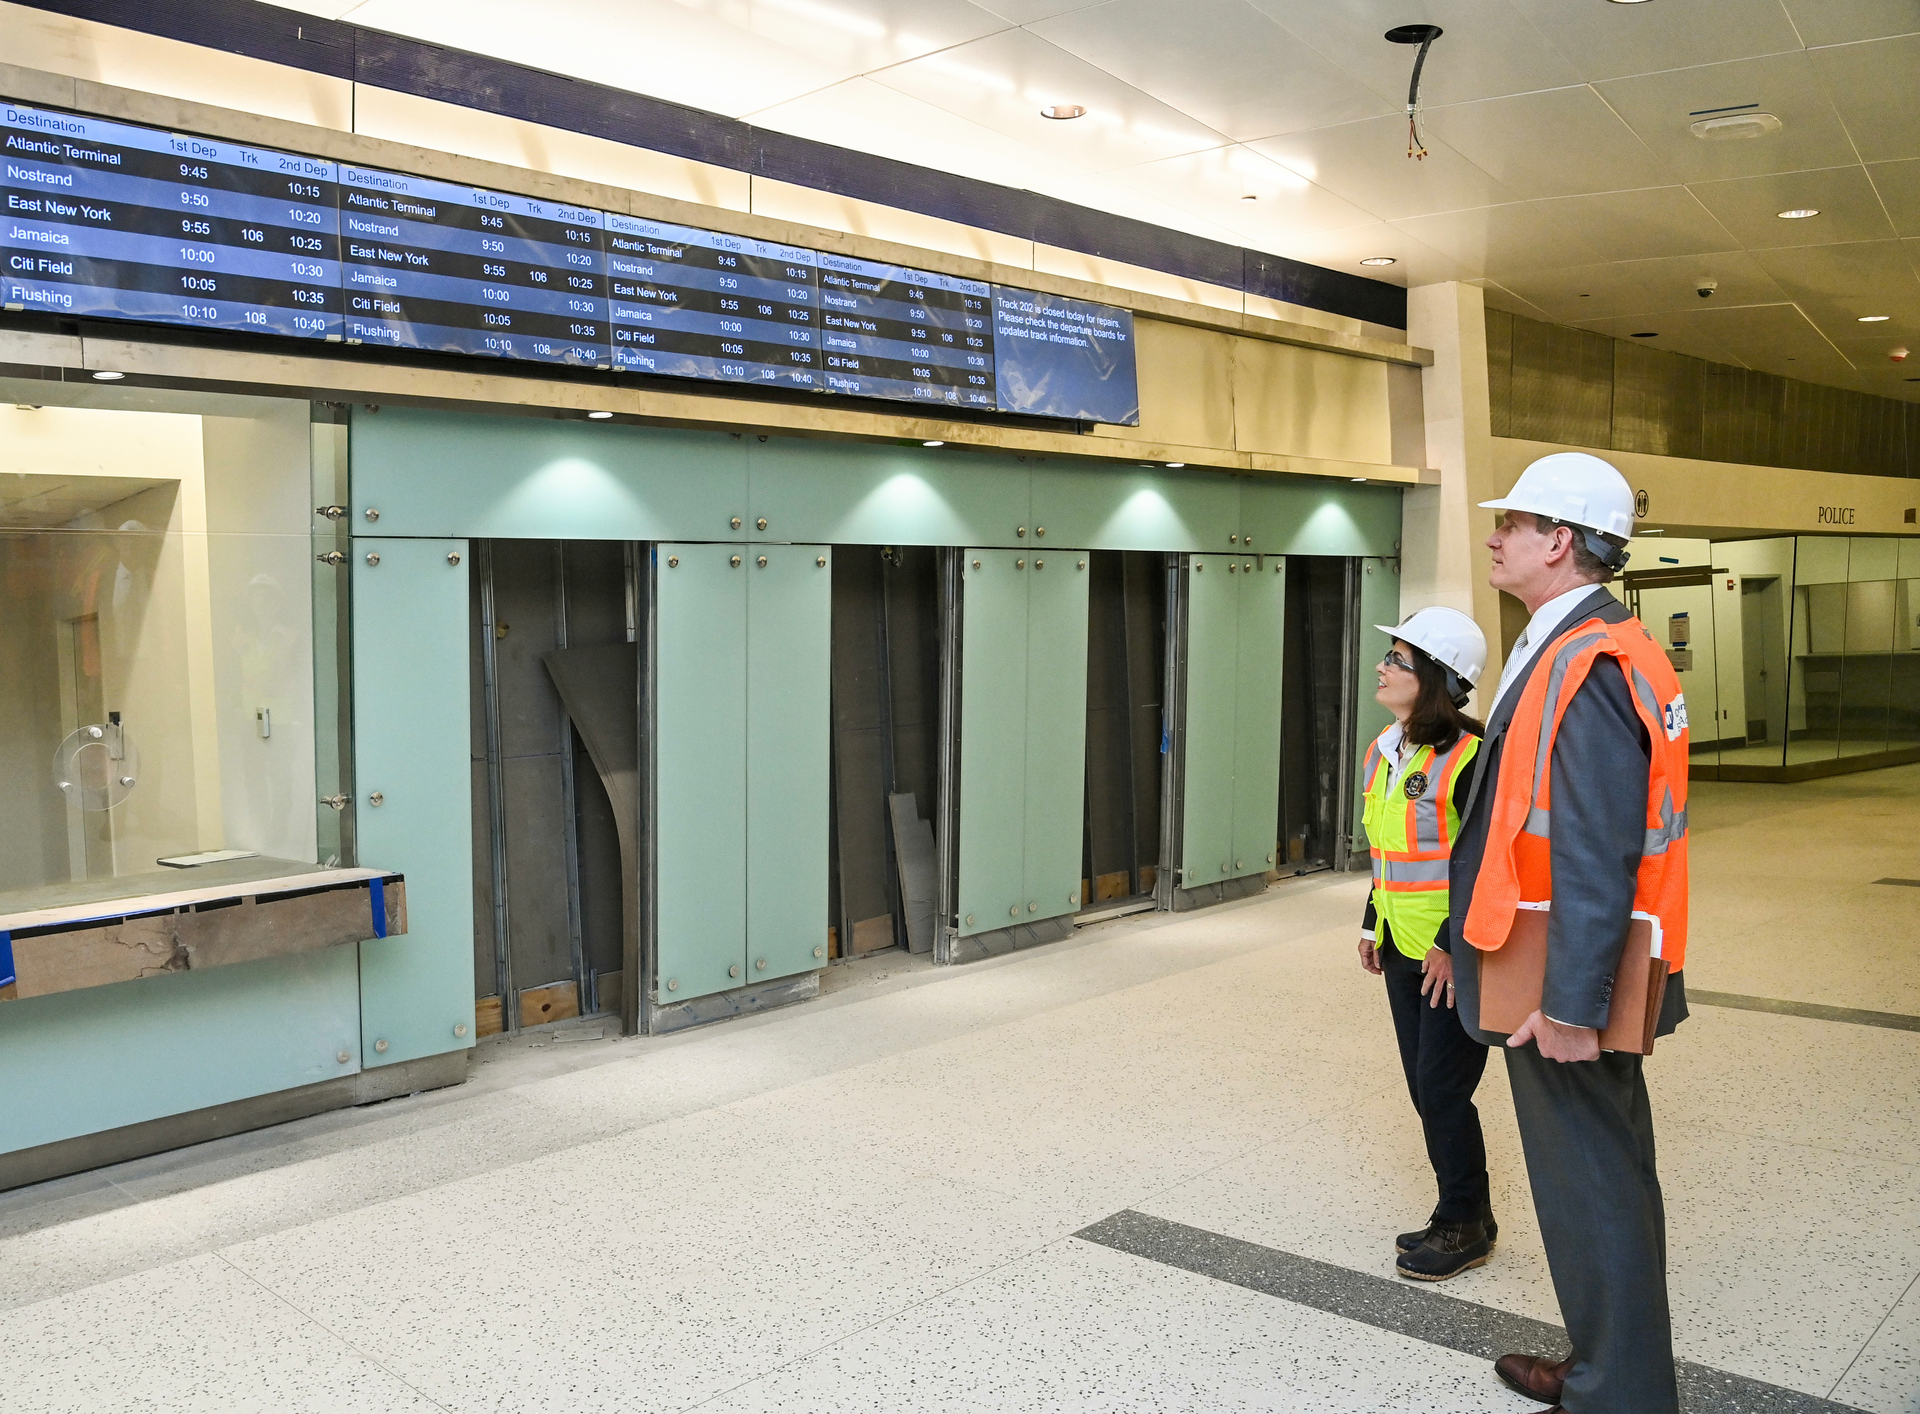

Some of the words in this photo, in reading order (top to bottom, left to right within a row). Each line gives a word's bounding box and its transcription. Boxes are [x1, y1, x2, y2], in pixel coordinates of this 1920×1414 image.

[7, 110, 85, 134] Destination
[170, 139, 188, 152] 1st
[192, 142, 217, 158] Dep
[240, 151, 258, 164] Trk
[279, 158, 300, 170] 2nd
[305, 162, 328, 178] Dep
[6, 136, 59, 155] Atlantic
[63, 145, 121, 165] Terminal
[180, 165, 208, 179] 9:45
[288, 183, 319, 197] 10:15
[7, 166, 72, 186] Nostrand
[181, 192, 209, 206] 9:50
[289, 210, 320, 224] 10:20
[348, 171, 408, 191] Destination
[473, 194, 487, 205] 1st
[490, 196, 510, 209] Dep
[527, 202, 542, 214] Trk
[558, 209, 575, 220] 2nd
[578, 211, 596, 225] Dep
[8, 196, 42, 211] East
[45, 201, 77, 216] New
[80, 206, 111, 221] York
[182, 220, 210, 235] 9:55
[241, 229, 263, 242] 106
[290, 236, 322, 250] 10:25
[348, 193, 388, 210] Atlantic
[391, 201, 435, 217] Terminal
[481, 216, 503, 228] 9:45
[565, 230, 590, 242] 10:15
[9, 226, 69, 244] Jamaica
[180, 248, 215, 263] 10:00
[291, 263, 323, 277] 10:30
[349, 219, 398, 236] Nostrand
[482, 240, 504, 252] 9:50
[566, 253, 591, 266] 10:20
[612, 219, 659, 235] Destination
[711, 236, 723, 246] 1st
[725, 238, 741, 250] Dep
[755, 244, 767, 254] Trk
[780, 249, 794, 258] 2nd
[796, 251, 810, 263] Dep
[612, 238, 644, 252] Atlantic
[646, 244, 682, 258] Terminal
[718, 256, 736, 267] 9:45
[786, 268, 806, 279] 10:15
[10, 256, 33, 270] Citi
[39, 260, 72, 275] Field
[181, 276, 216, 291] 10:05
[292, 290, 324, 304] 10:35
[350, 245, 375, 259] East
[378, 249, 402, 262] New
[405, 253, 429, 266] York
[484, 264, 505, 277] 9:55
[530, 271, 547, 282] 106
[568, 277, 592, 289] 10:25
[613, 261, 653, 275] Nostrand
[720, 278, 737, 288] 9:50
[787, 289, 807, 299] 10:20
[823, 257, 862, 271] Destination
[904, 273, 913, 282] 1st
[915, 274, 928, 285] Dep
[939, 278, 949, 287] Trk
[960, 282, 971, 291] 2nd
[973, 285, 985, 294] Dep
[12, 286, 72, 307] Flushing
[182, 305, 217, 319] 10:10
[245, 311, 266, 324] 108
[293, 317, 325, 331] 10:40
[351, 272, 397, 287] Jamaica
[483, 289, 509, 301] 10:00
[569, 300, 594, 312] 10:30
[615, 284, 634, 296] East
[637, 287, 656, 298] New
[658, 290, 677, 302] York
[721, 299, 738, 310] 9:55
[758, 305, 772, 315] 106
[788, 310, 808, 321] 10:25
[824, 275, 850, 287] Atlantic
[851, 279, 880, 292] Terminal
[909, 290, 923, 299] 9:45
[965, 299, 981, 309] 10:15
[353, 298, 371, 310] Citi
[374, 301, 400, 313] Field
[484, 313, 510, 326] 10:05
[570, 324, 595, 336] 10:35
[615, 307, 652, 320] Jamaica
[720, 321, 742, 332] 10:00
[790, 331, 809, 341] 10:30
[825, 295, 856, 308] Nostrand
[910, 309, 924, 319] 9:50
[966, 318, 982, 328] 10:20
[998, 297, 1018, 310] Track
[1020, 302, 1033, 312] 202
[1035, 305, 1041, 313] is
[1043, 307, 1064, 318] closed
[1067, 310, 1085, 323] today
[1087, 314, 1095, 323] for
[1097, 318, 1120, 328] repairs.
[999, 311, 1023, 324] Please
[1025, 317, 1046, 328] check
[1048, 321, 1059, 330] the
[1060, 323, 1092, 335] departure
[1094, 328, 1115, 339] boards
[1117, 331, 1126, 341] for
[354, 324, 400, 341] Flushing
[485, 338, 511, 350] 10:10
[533, 344, 550, 355] 108
[571, 348, 596, 360] 10:40
[616, 330, 631, 341] Citi
[634, 333, 654, 343] Field
[721, 343, 743, 354] 10:05
[790, 352, 810, 363] 10:35
[826, 316, 842, 326] East
[844, 319, 859, 328] New
[861, 321, 876, 331] York
[911, 329, 926, 338] 9:55
[967, 337, 983, 347] 10:25
[999, 326, 1028, 338] updated
[1031, 330, 1048, 341] track
[1050, 333, 1088, 347] information.
[618, 354, 654, 368] Flushing
[722, 365, 744, 376] 10:10
[761, 370, 775, 379] 108
[792, 373, 812, 384] 10:40
[827, 337, 856, 348] Jamaica
[911, 349, 929, 358] 10:00
[967, 356, 984, 366] 10:30
[828, 357, 840, 367] Citi
[842, 359, 859, 369] Field
[913, 368, 930, 377] 10:05
[969, 376, 985, 385] 10:35
[830, 378, 859, 390] Flushing
[914, 388, 931, 397] 10:10
[970, 394, 986, 403] 10:40
[1818, 507, 1855, 524] POLICE
